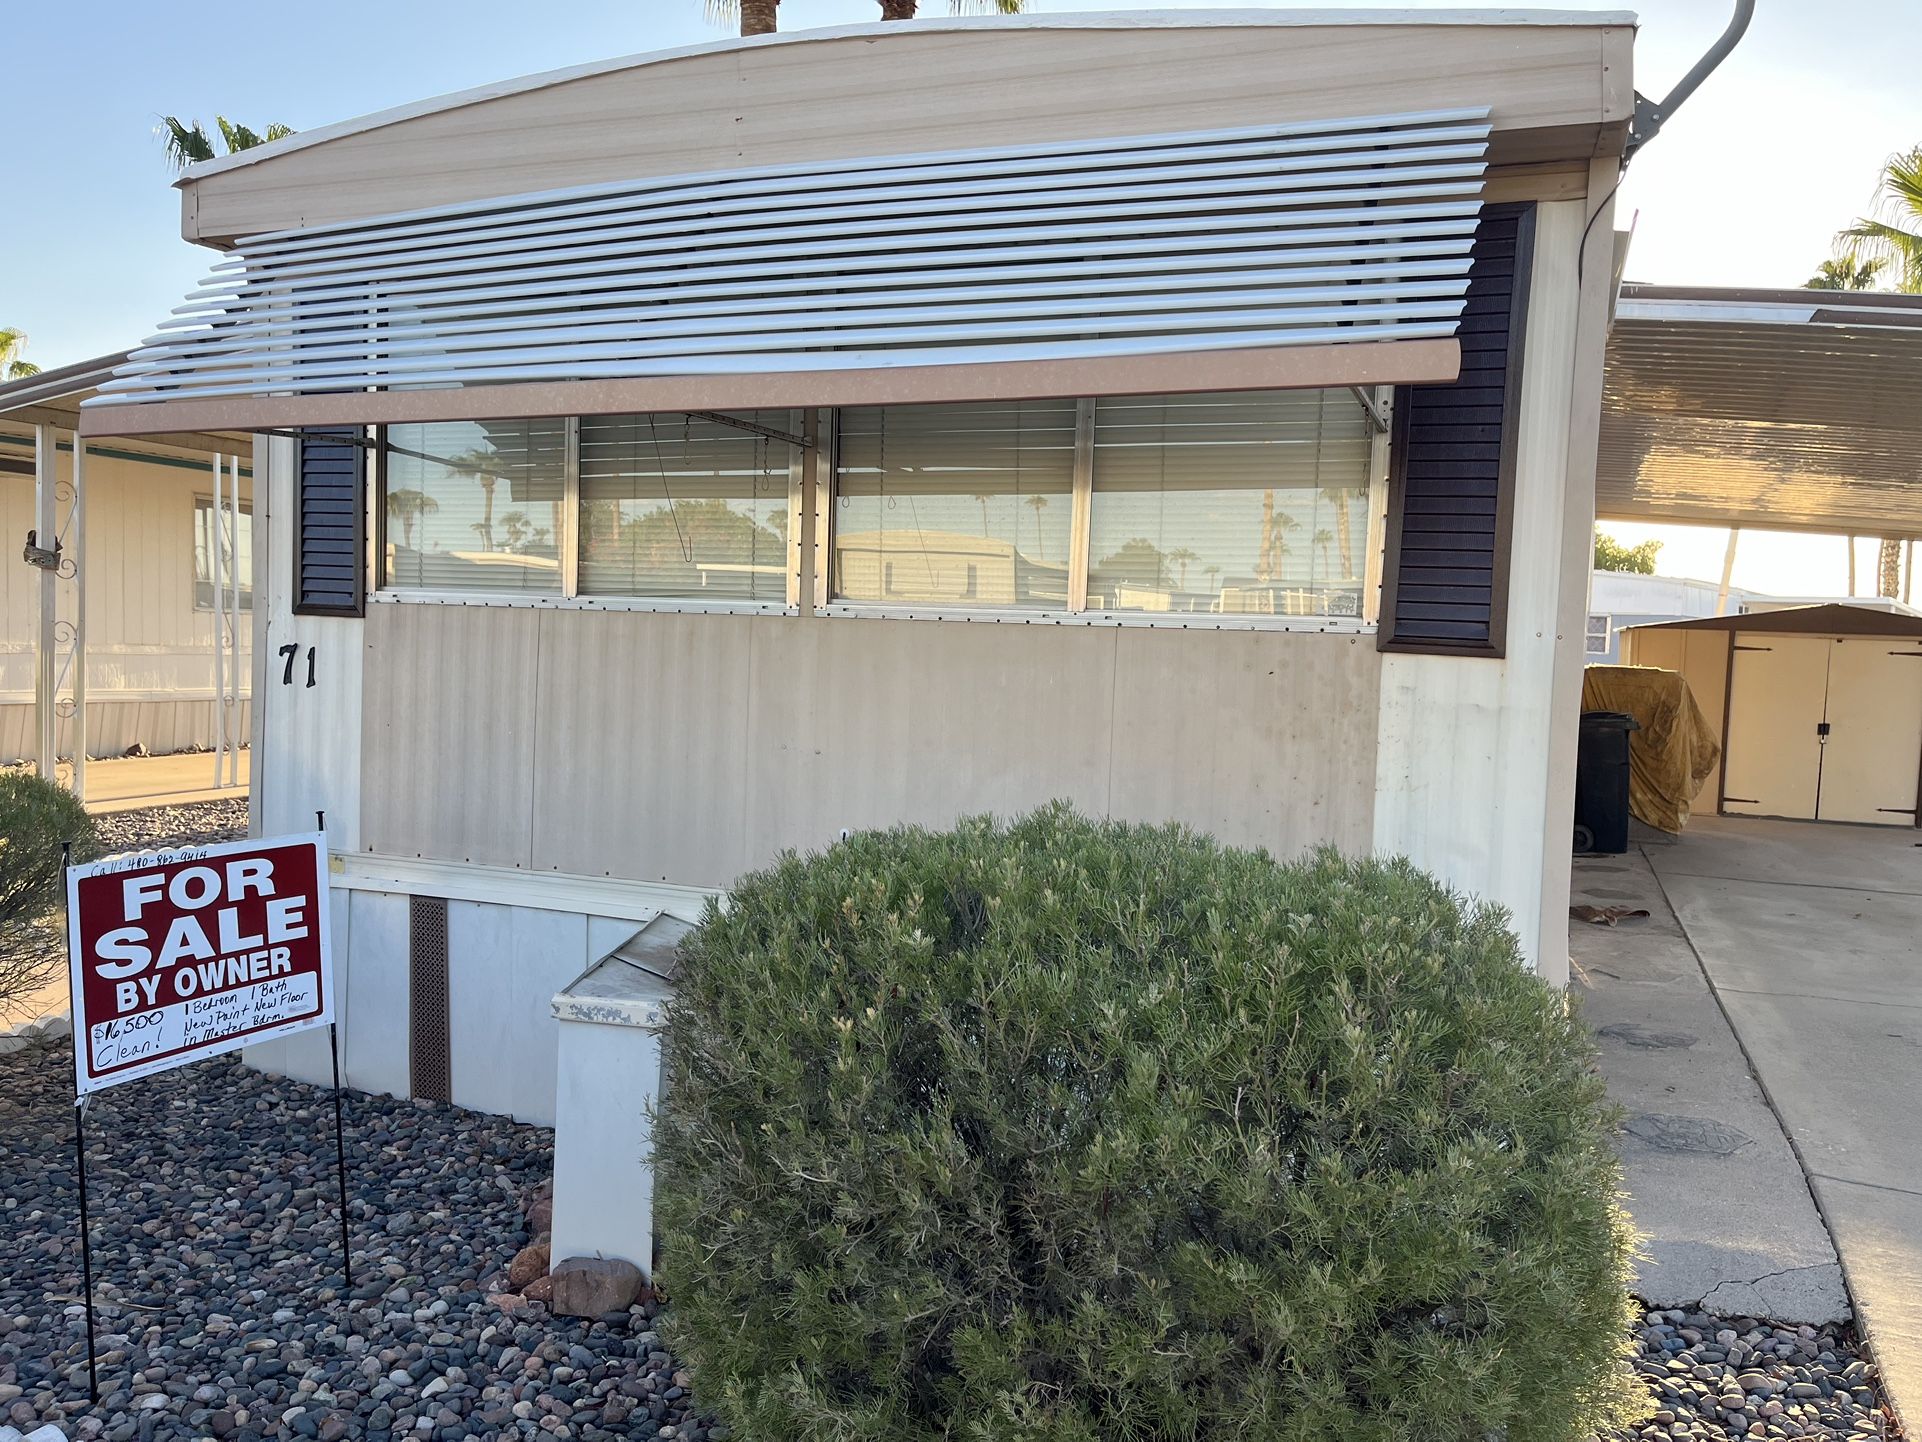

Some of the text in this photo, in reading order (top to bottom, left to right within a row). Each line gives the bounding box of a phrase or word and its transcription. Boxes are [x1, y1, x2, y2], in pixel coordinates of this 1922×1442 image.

[279, 643, 316, 688] 71
[91, 862, 122, 877] Call:
[122, 858, 276, 922] FOR
[94, 894, 309, 980] SALE
[116, 946, 292, 1013] BY OWNER
[193, 994, 237, 1013] Bedroom
[259, 979, 287, 997] Bath
[184, 1015, 213, 1033] New
[215, 1005, 250, 1024] Paint
[254, 999, 278, 1013] New
[280, 991, 309, 1006] Floor
[184, 1013, 285, 1047] in Master Bdrm.
[97, 1026, 162, 1068] Clean!
